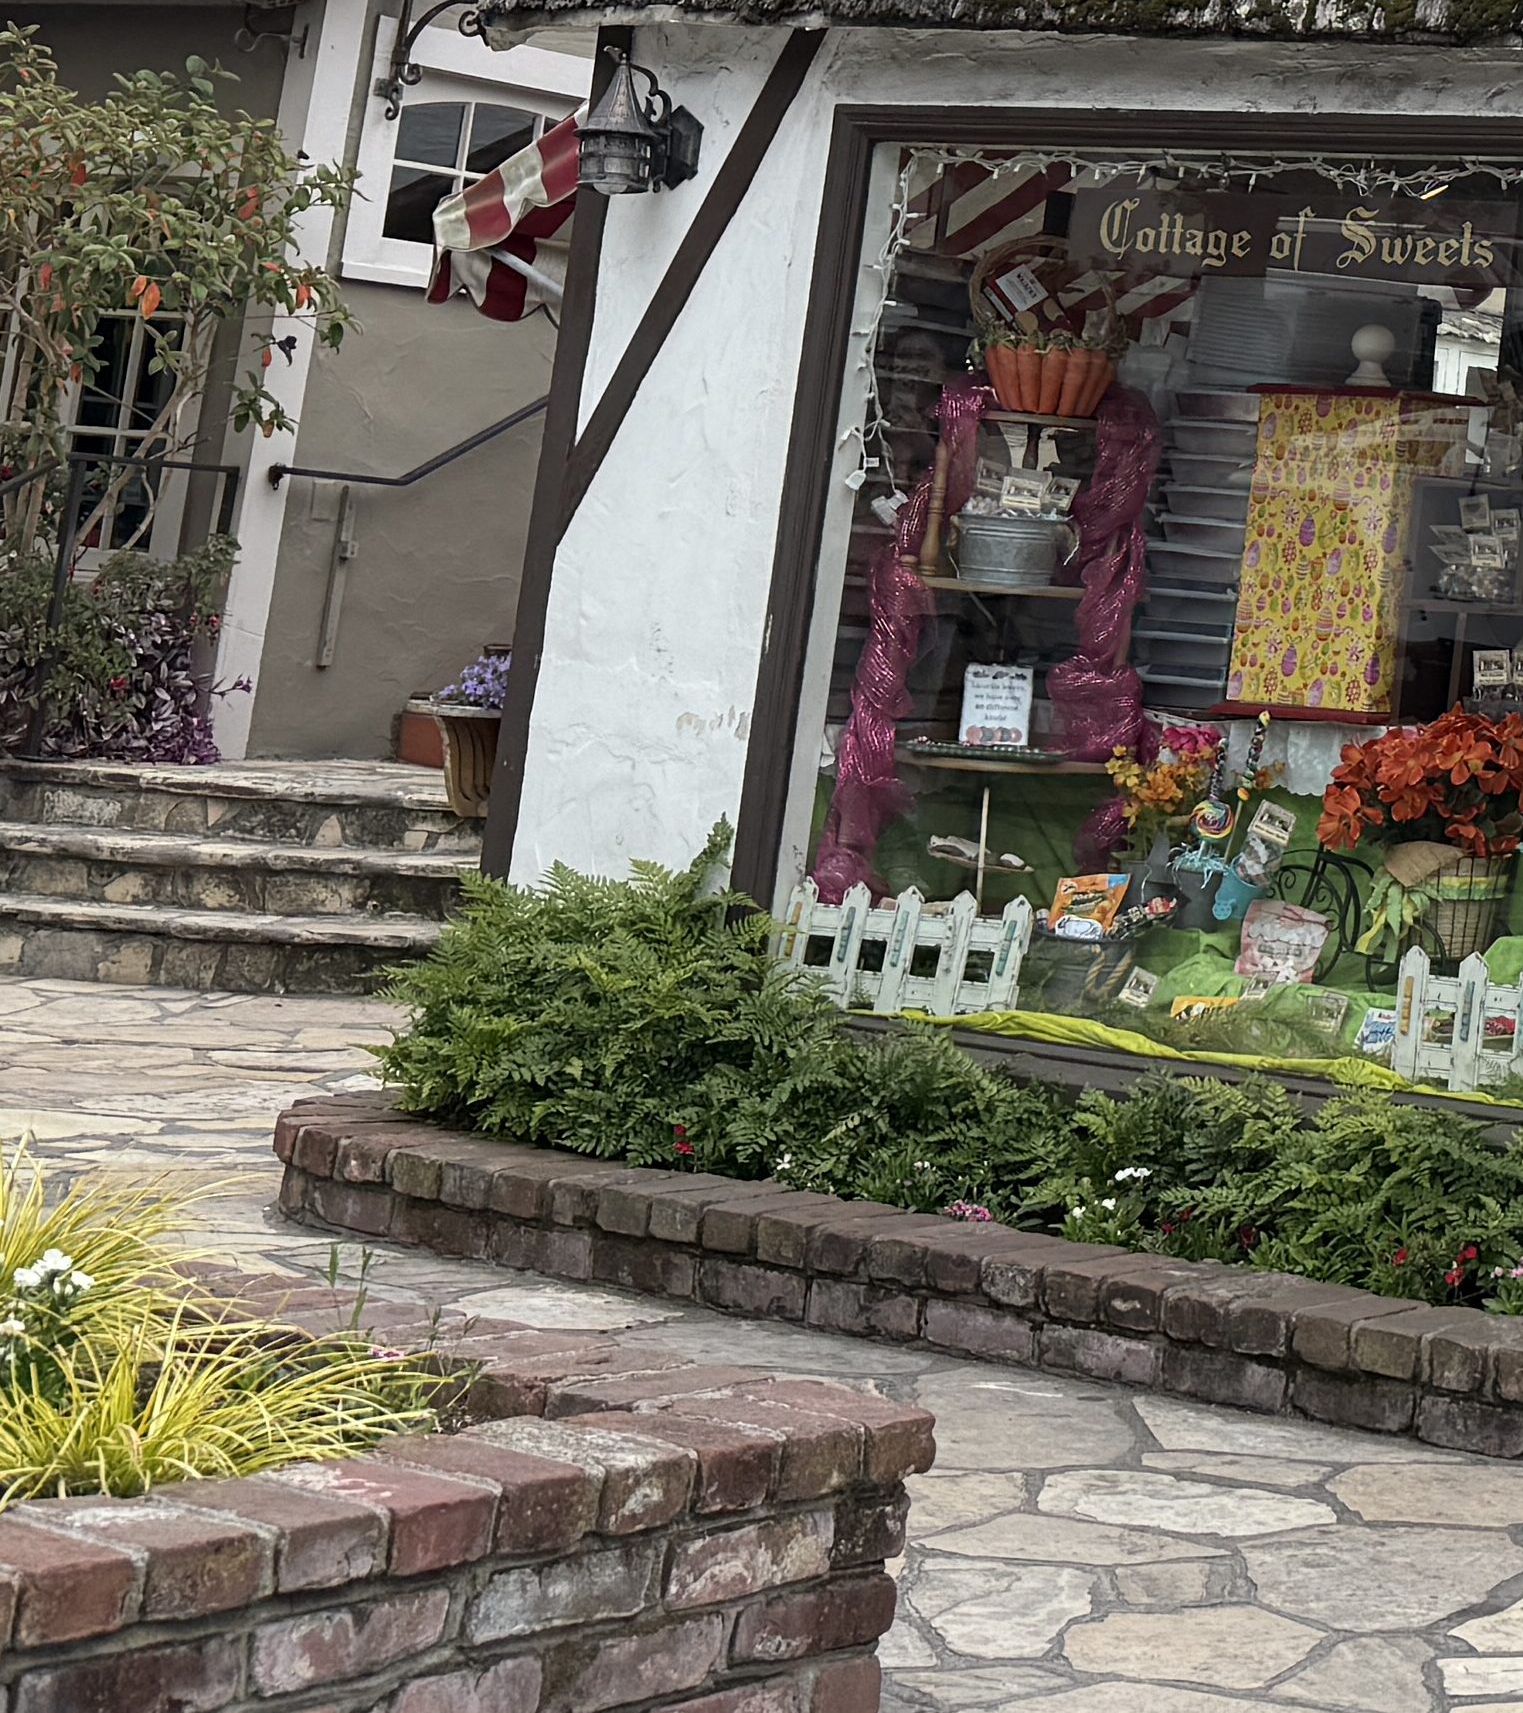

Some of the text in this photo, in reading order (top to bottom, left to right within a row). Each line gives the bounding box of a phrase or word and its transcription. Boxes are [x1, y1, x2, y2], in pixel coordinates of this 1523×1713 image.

[1099, 197, 1495, 271] Cottage of Sweets
